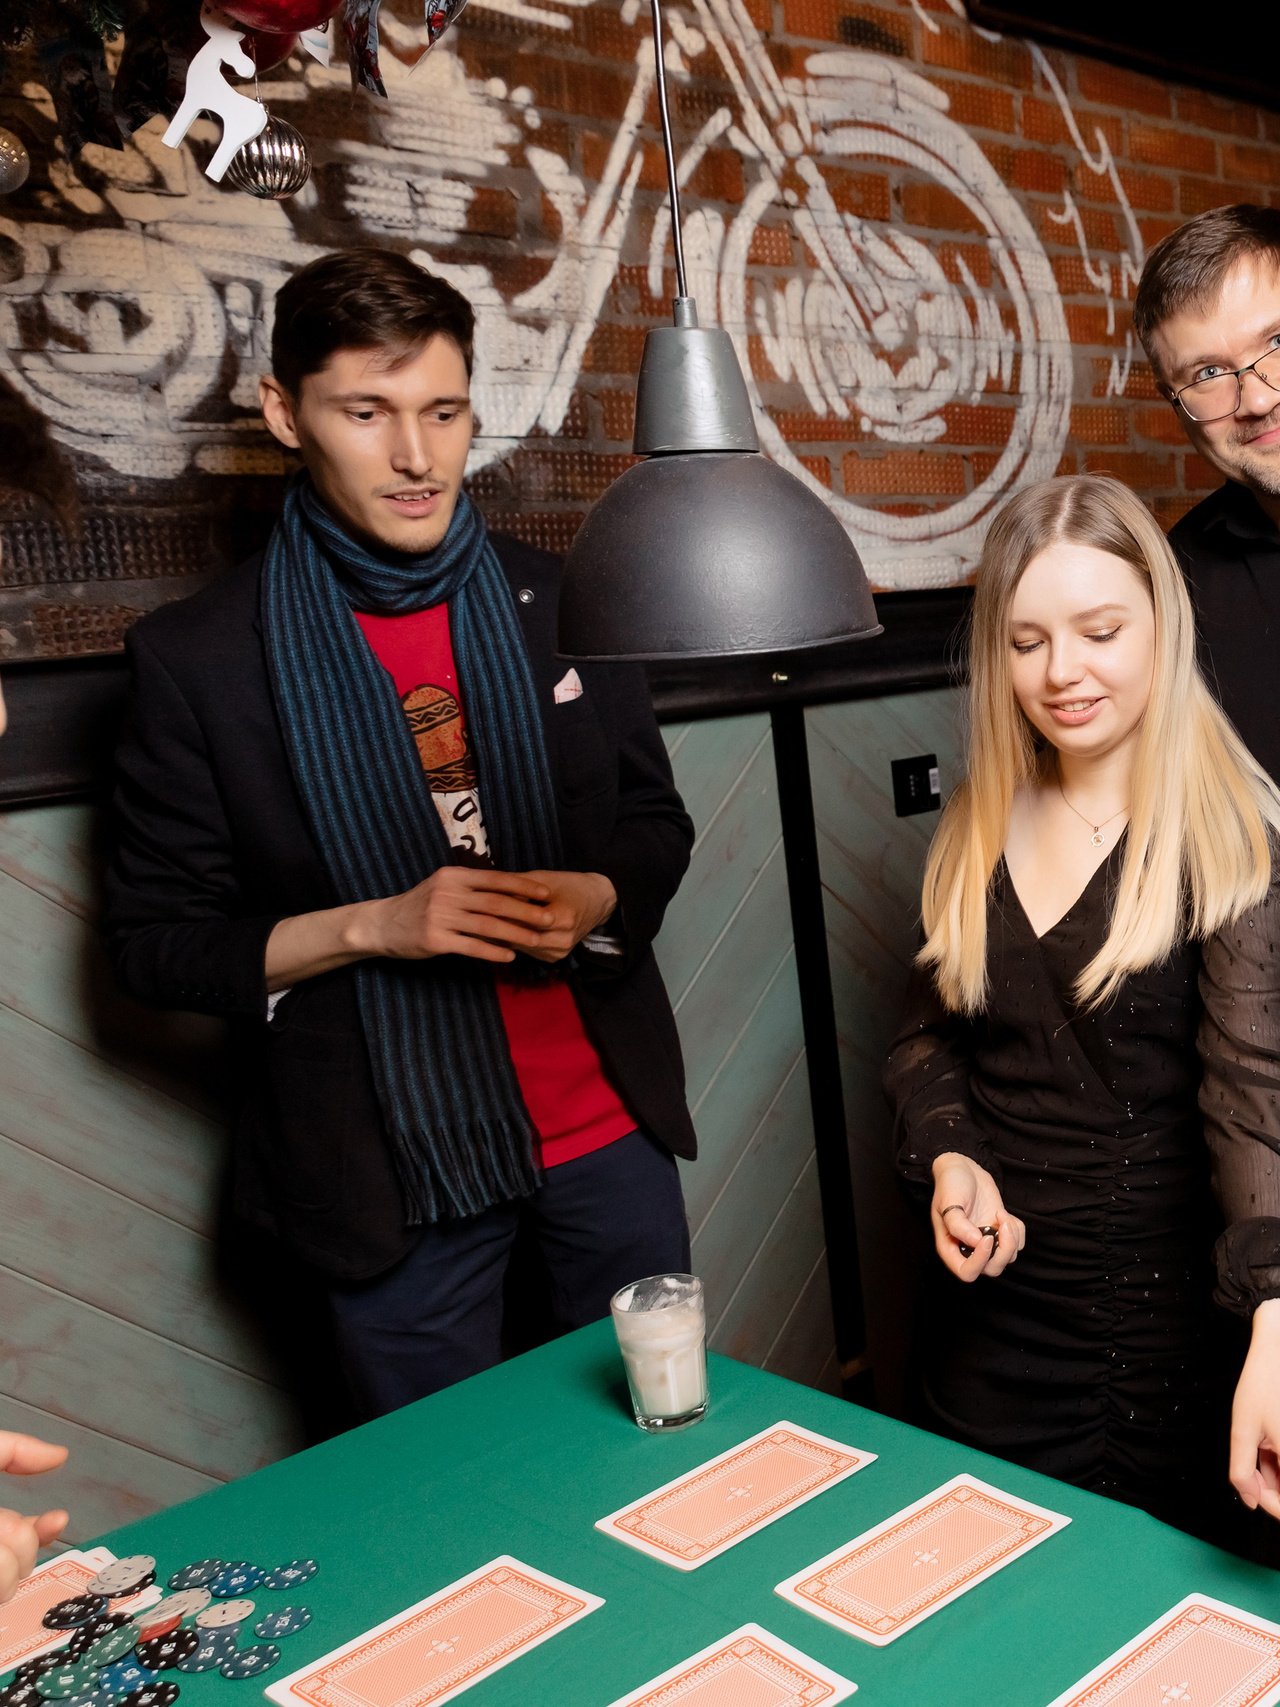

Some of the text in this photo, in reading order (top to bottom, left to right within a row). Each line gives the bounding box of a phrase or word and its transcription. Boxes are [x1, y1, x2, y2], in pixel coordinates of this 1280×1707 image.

[231, 1575, 247, 1585] 25
[97, 1622, 114, 1631] 50
[160, 1642, 176, 1654] 50
[59, 1674, 75, 1685] 10
[138, 1692, 157, 1704] 50
